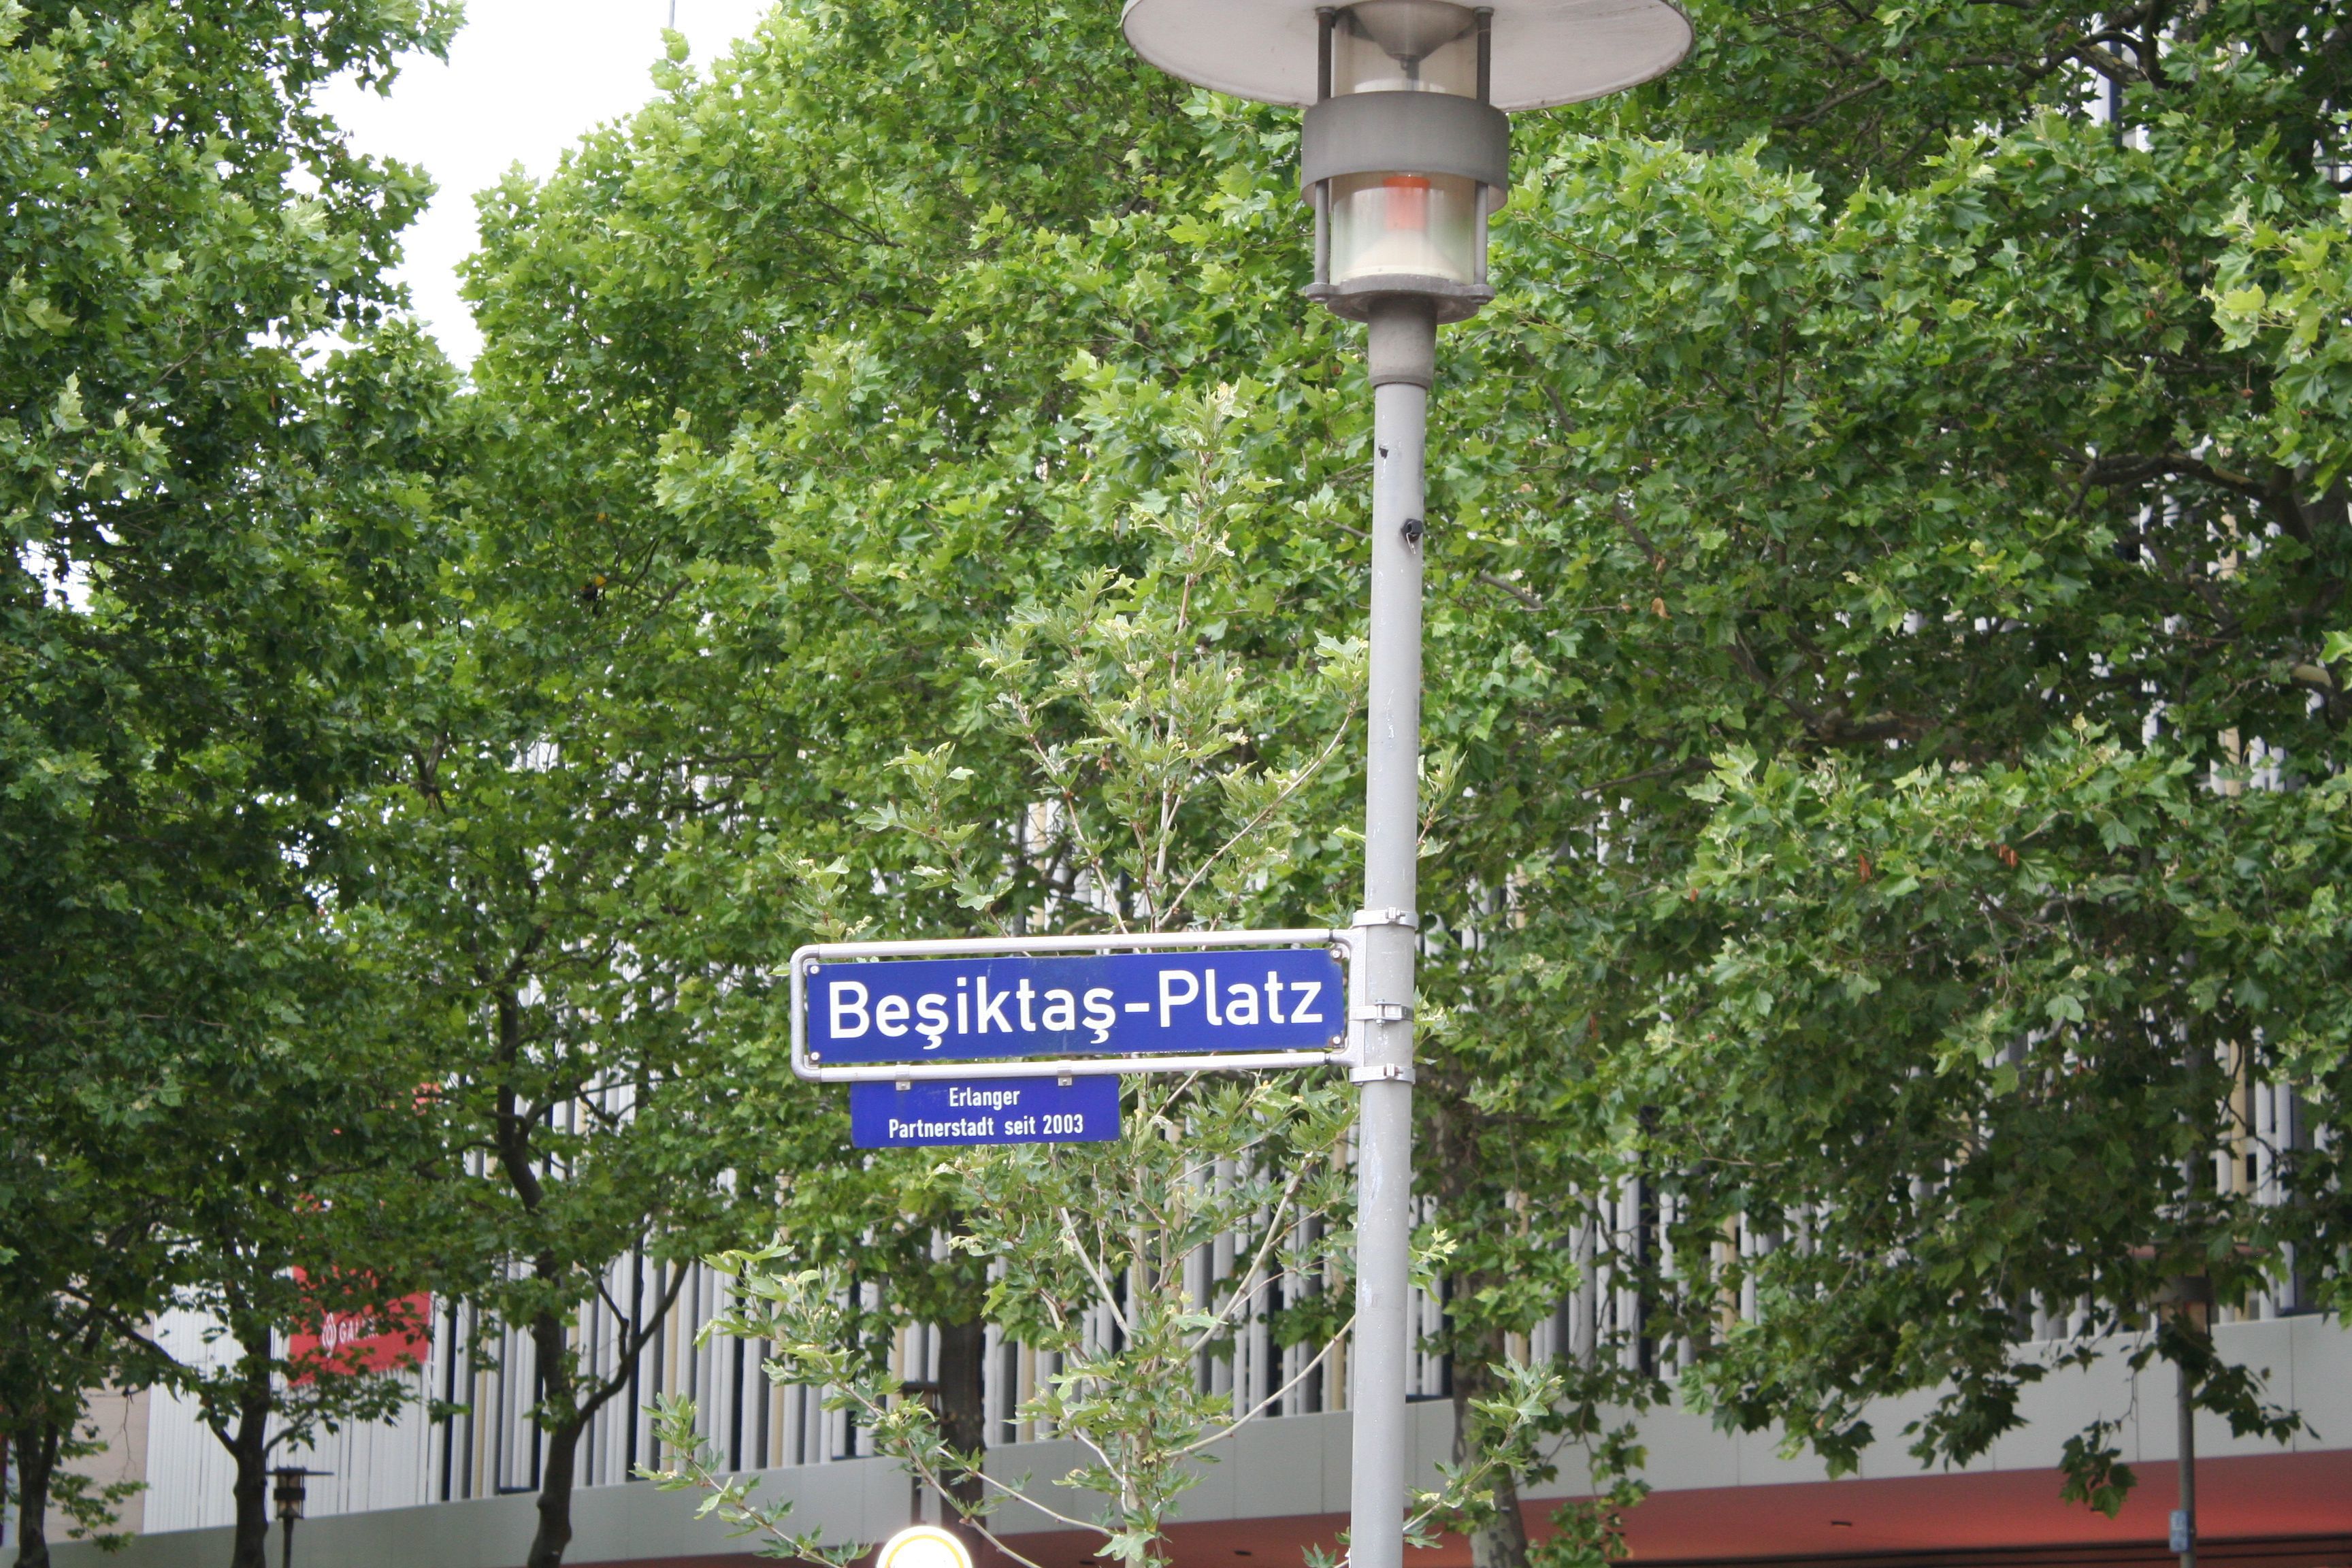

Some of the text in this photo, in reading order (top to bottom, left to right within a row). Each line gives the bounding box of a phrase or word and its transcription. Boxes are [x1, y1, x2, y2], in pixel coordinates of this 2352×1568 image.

[829, 968, 1323, 1050] Beşiktaş-Platz
[949, 1086, 1020, 1111] Erlanger
[889, 1113, 1083, 1139] Partnerstadt seit 2003
